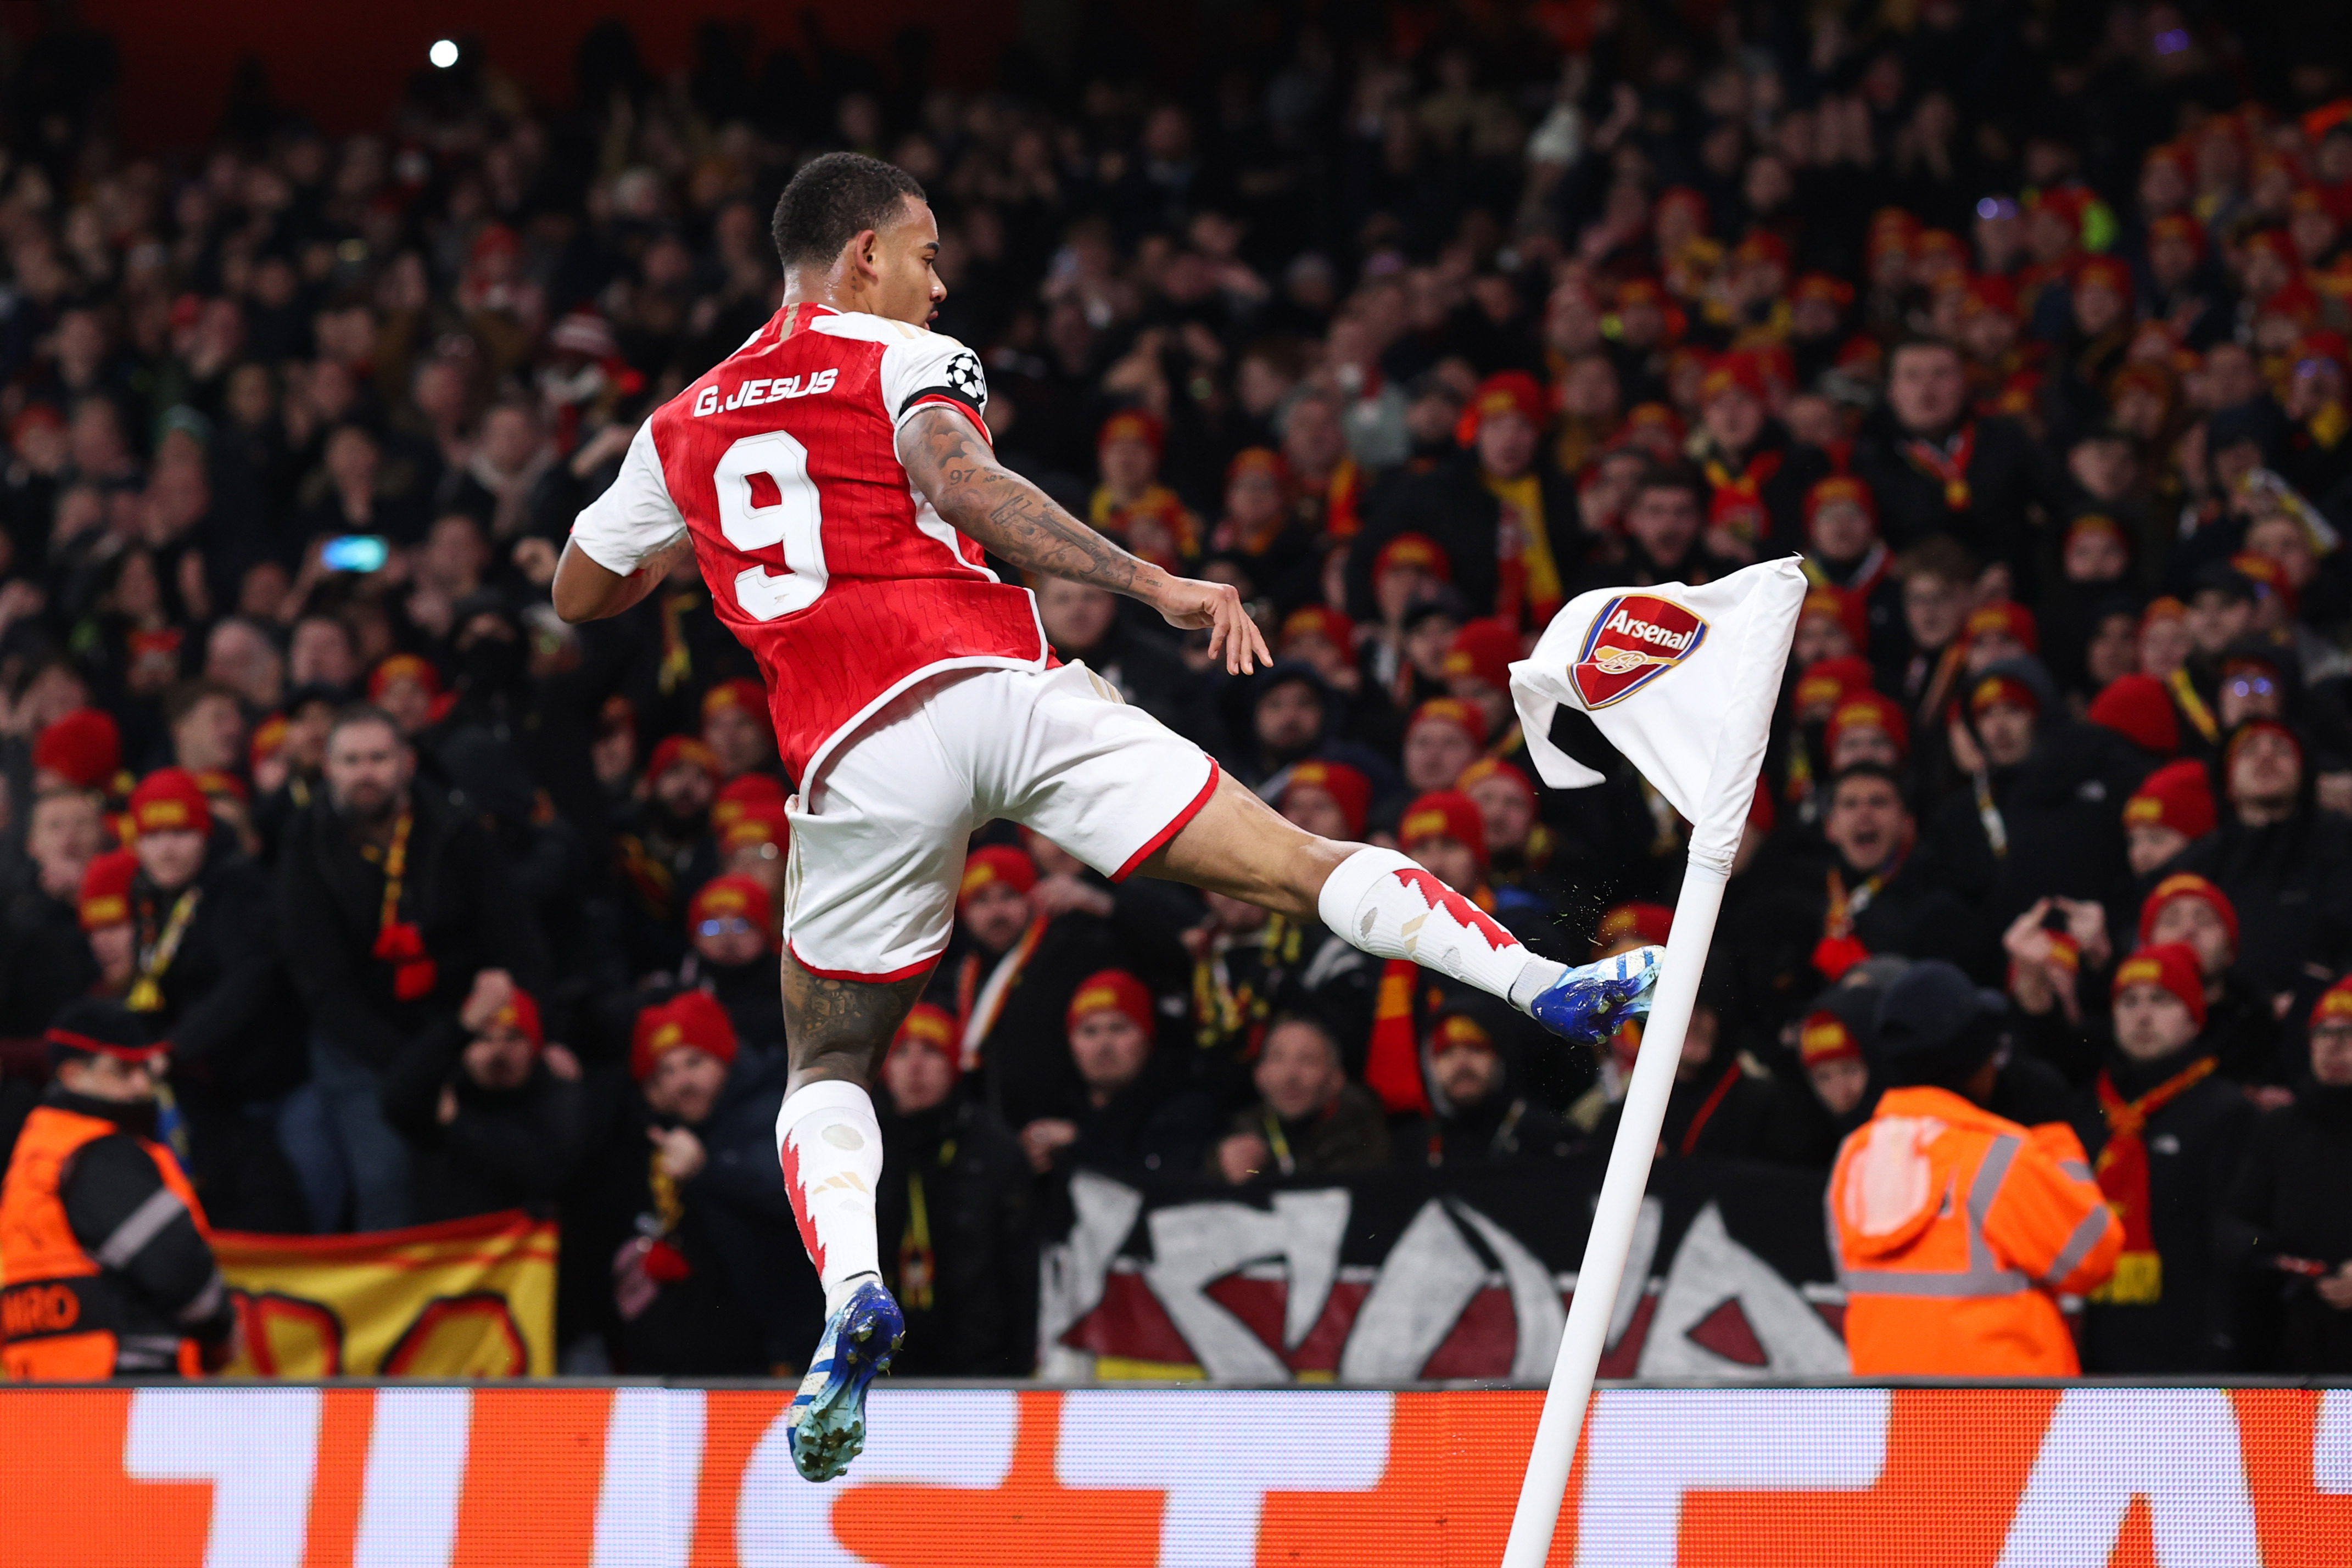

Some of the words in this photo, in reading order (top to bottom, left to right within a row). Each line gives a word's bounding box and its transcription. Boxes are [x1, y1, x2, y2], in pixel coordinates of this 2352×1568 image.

[693, 368, 839, 417] G.JESUS
[949, 468, 976, 485] 97
[713, 430, 829, 622] 9
[1605, 609, 1694, 651] Arsenal
